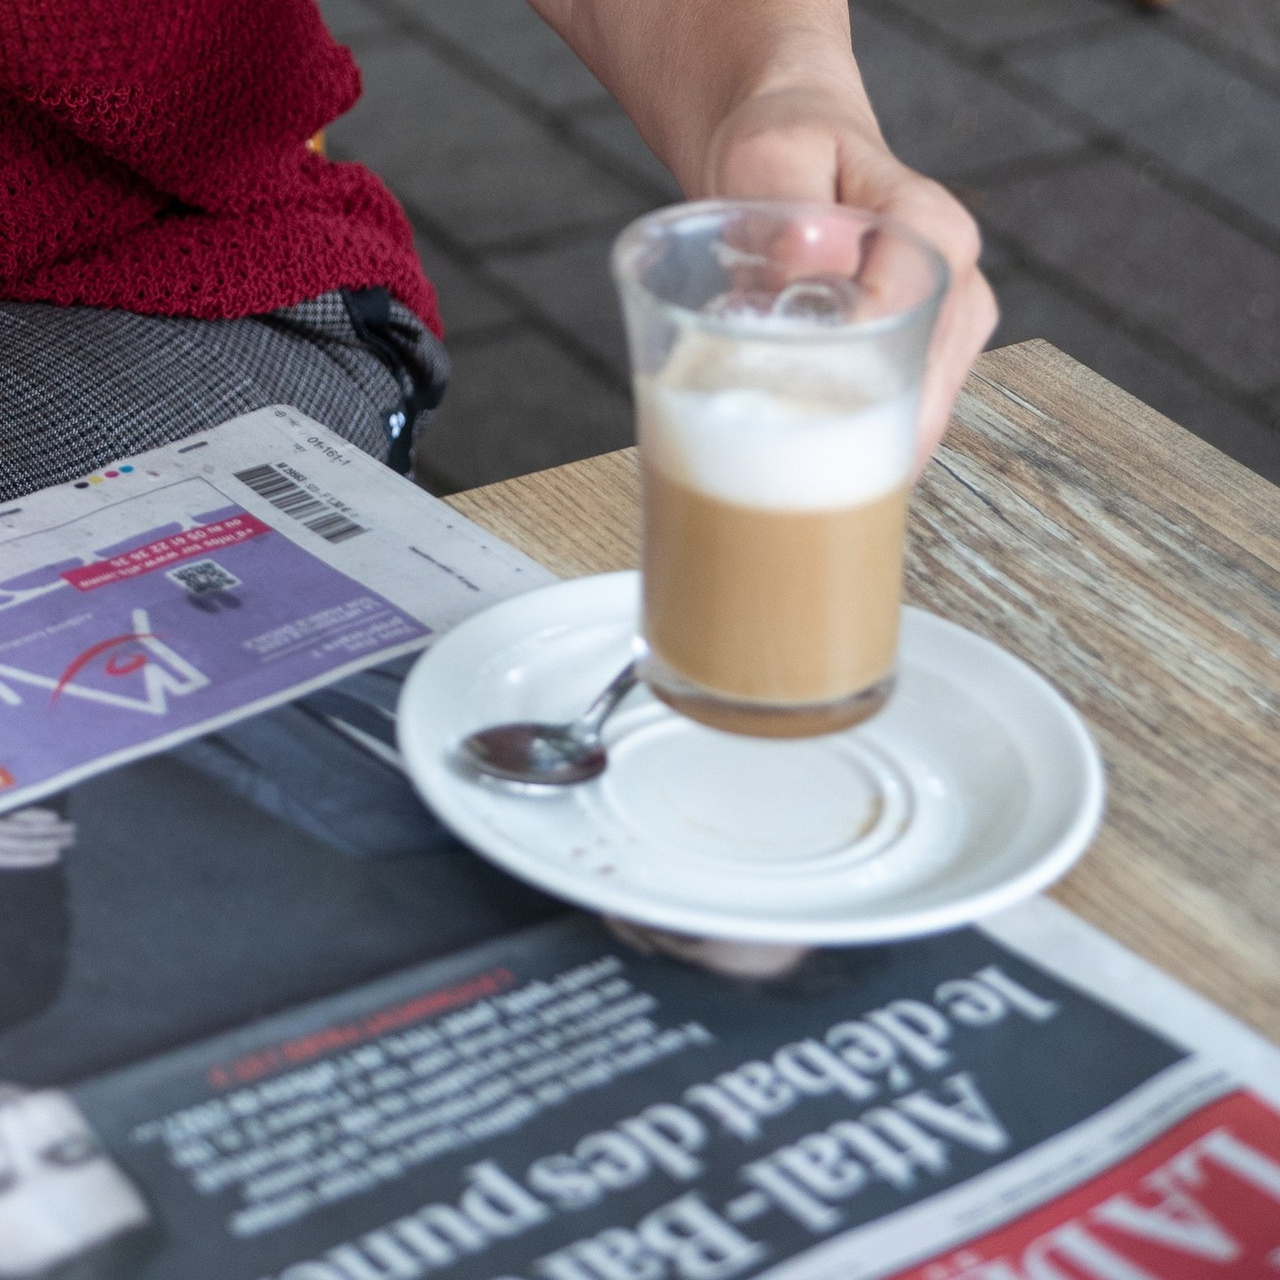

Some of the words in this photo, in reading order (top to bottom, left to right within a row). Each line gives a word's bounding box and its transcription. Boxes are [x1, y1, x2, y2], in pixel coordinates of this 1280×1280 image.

[302, 436, 354, 466] 01-161-1
[175, 542, 203, 555] sur
[932, 962, 1060, 1029] le
[682, 995, 954, 1142] débat
[526, 1097, 712, 1210] des
